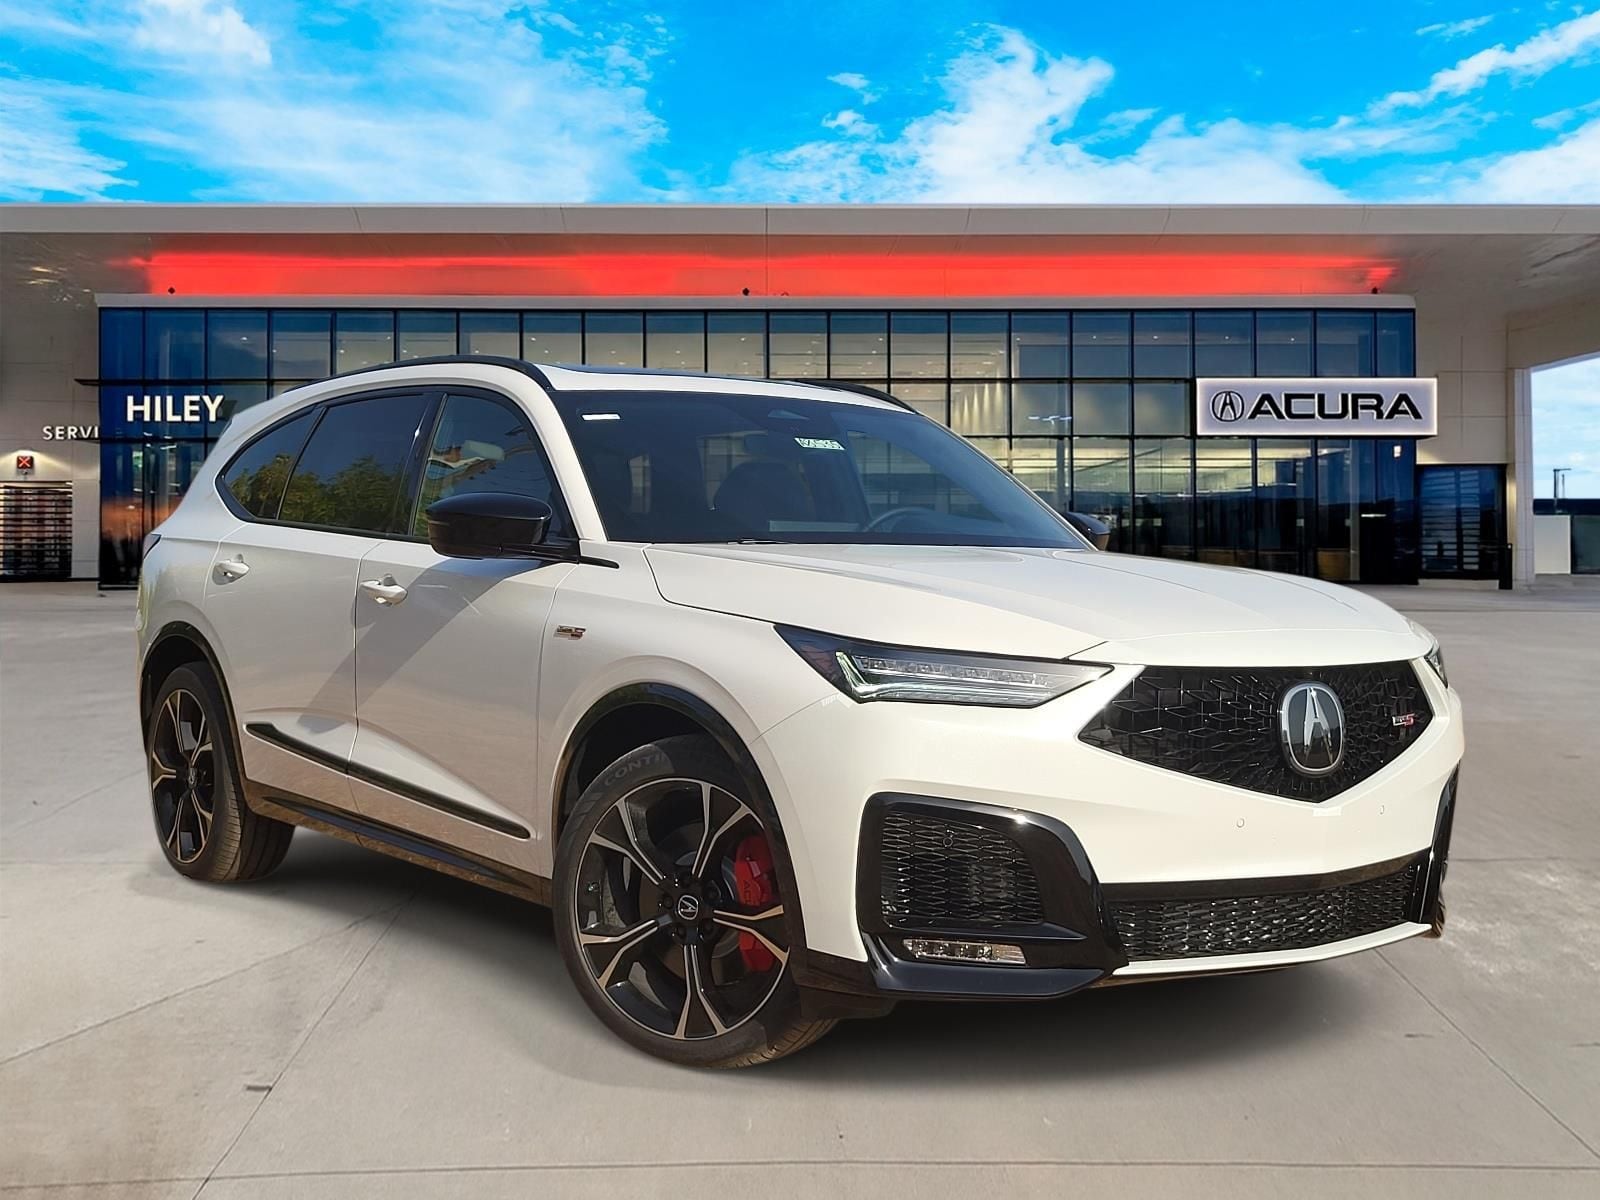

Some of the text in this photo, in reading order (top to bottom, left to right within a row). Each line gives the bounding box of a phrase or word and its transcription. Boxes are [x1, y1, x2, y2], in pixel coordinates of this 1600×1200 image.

[126, 395, 225, 422] HILEY
[1247, 393, 1423, 420] ACURA
[42, 425, 99, 441] SERVI
